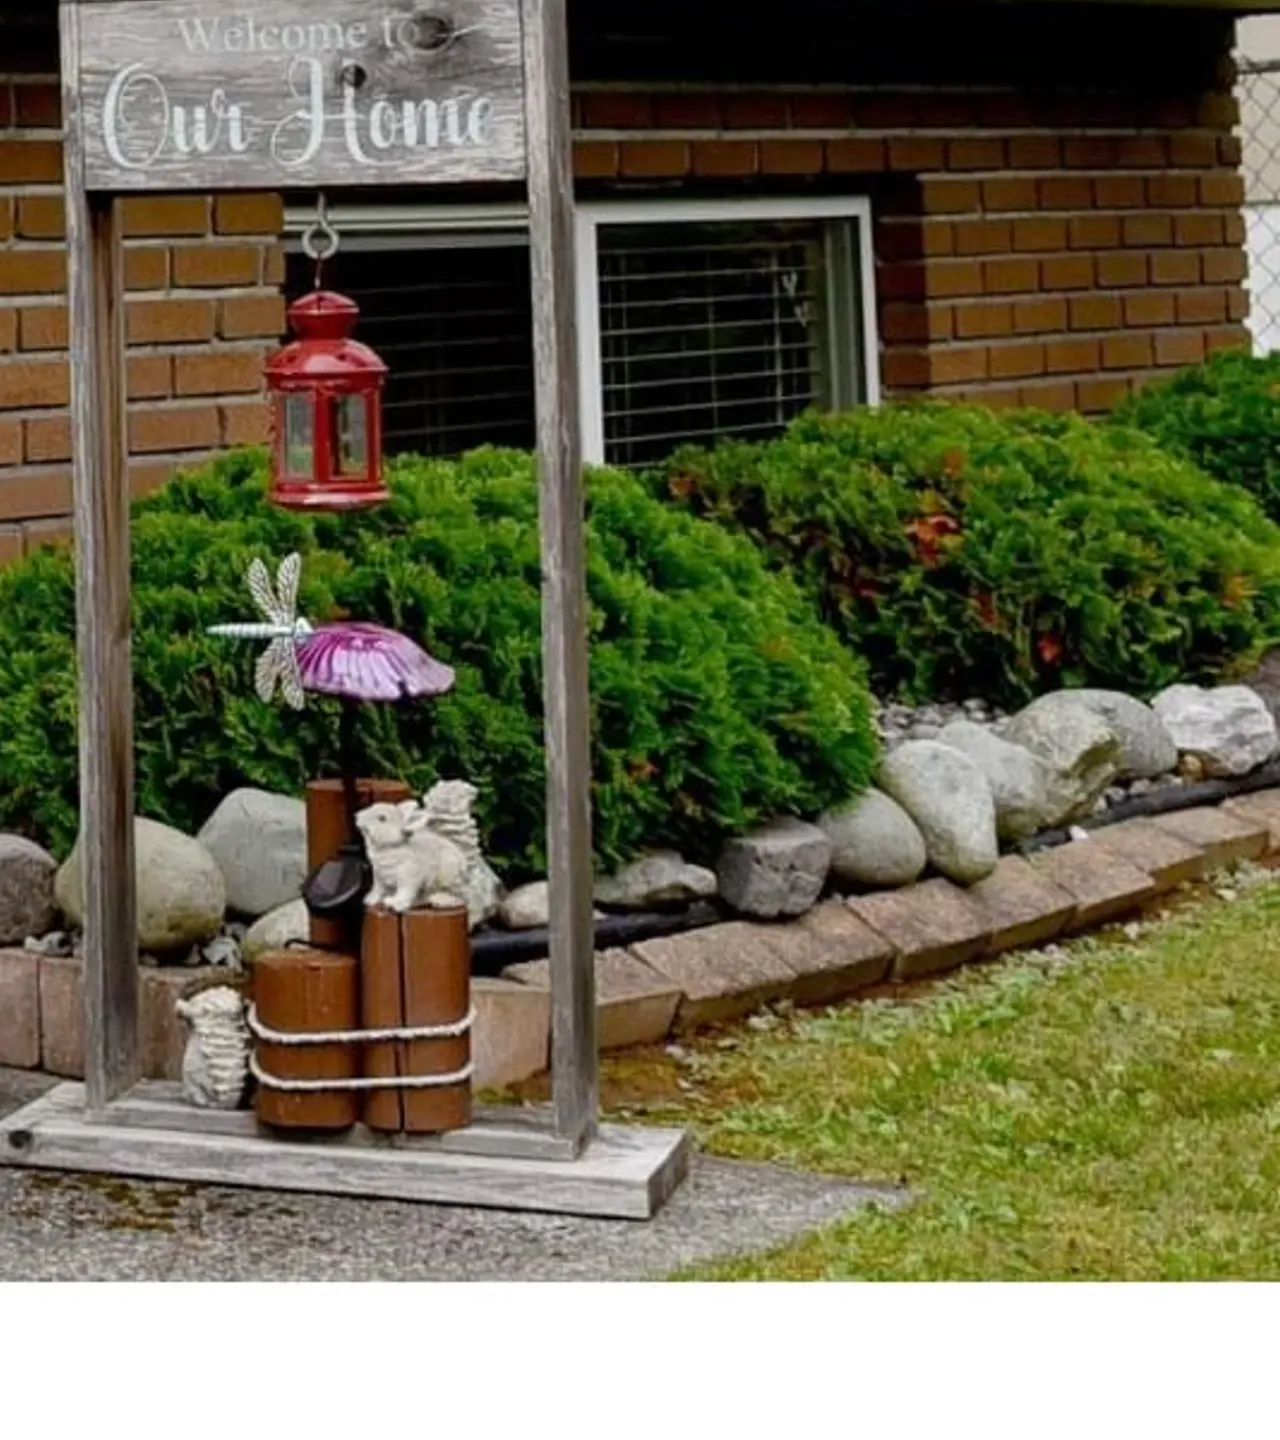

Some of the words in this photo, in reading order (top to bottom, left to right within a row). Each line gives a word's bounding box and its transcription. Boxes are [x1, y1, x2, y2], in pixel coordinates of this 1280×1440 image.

[178, 16, 368, 54] Welcome
[103, 62, 250, 168] Our
[271, 58, 496, 168] Home
